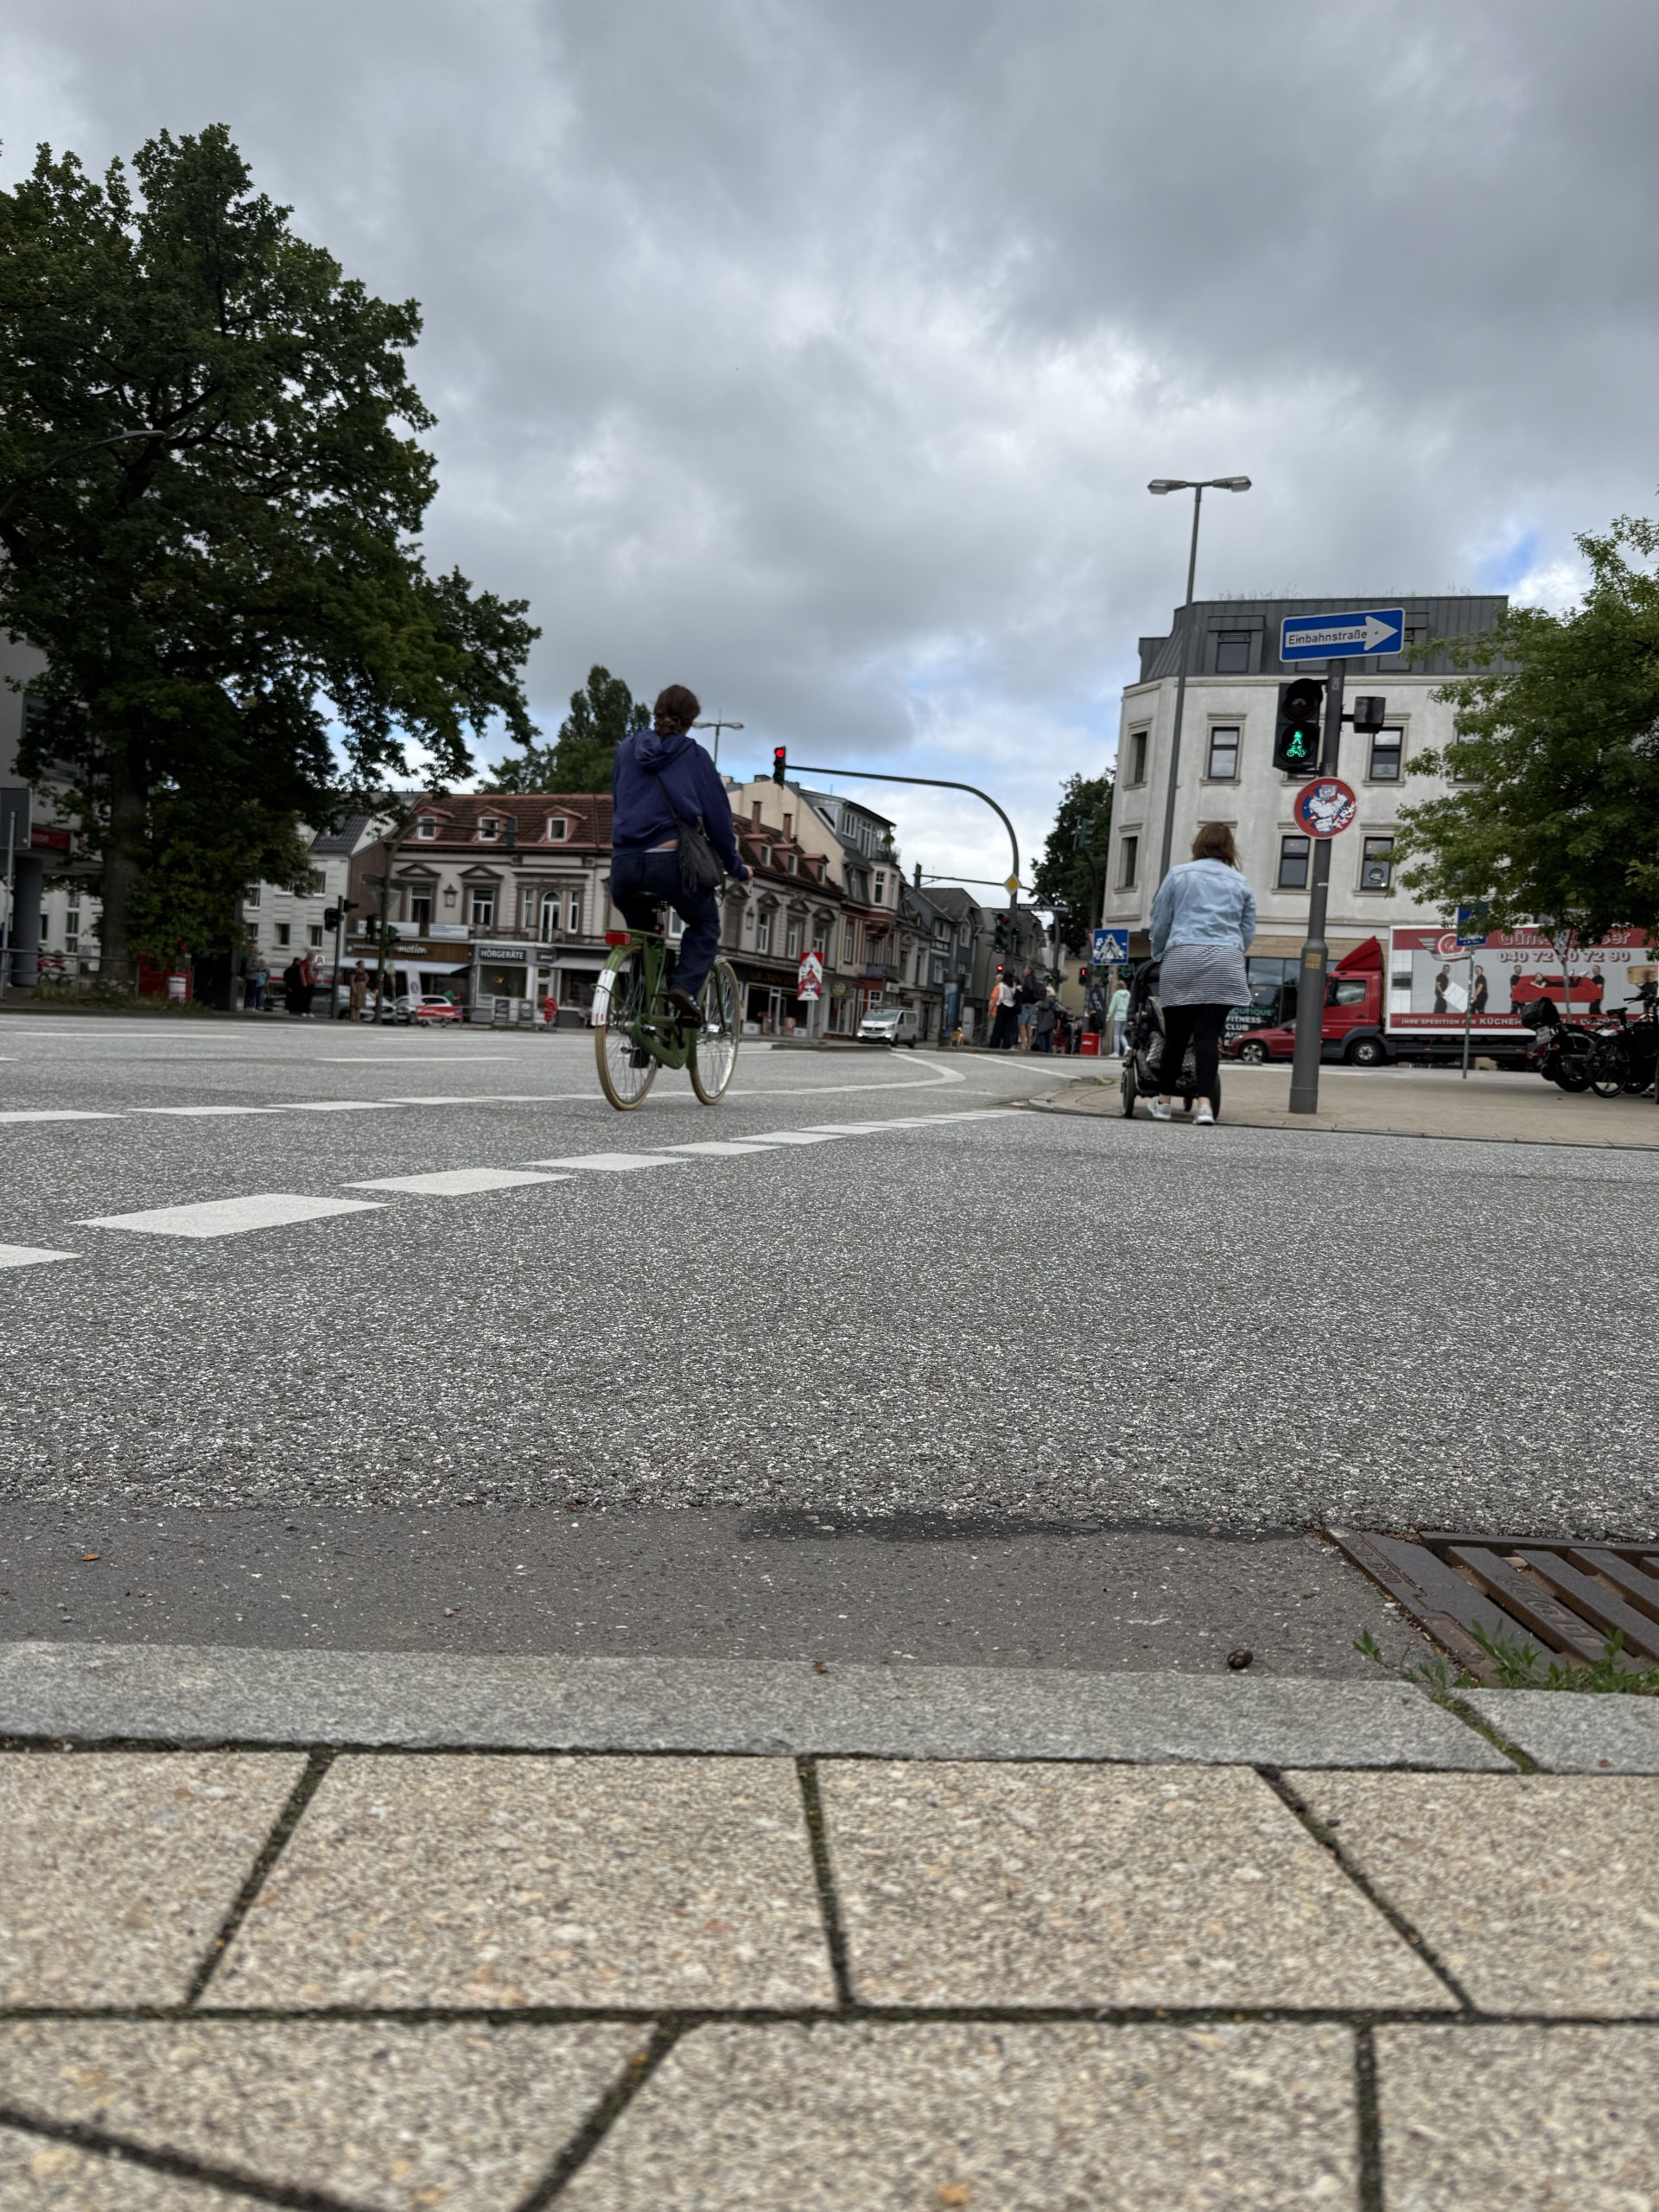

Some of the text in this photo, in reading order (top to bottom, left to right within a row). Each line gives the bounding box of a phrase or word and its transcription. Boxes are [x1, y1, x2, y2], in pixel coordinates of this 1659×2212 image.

[1288, 629, 1368, 645] Einbahnstraße
[480, 949, 524, 960] HÖRGERÄTE
[1498, 951, 1528, 963] 040
[1533, 951, 1554, 963] 72
[1584, 950, 1605, 962] 72
[1610, 950, 1630, 962] 90
[1230, 1007, 1272, 1016] OUTIQUE
